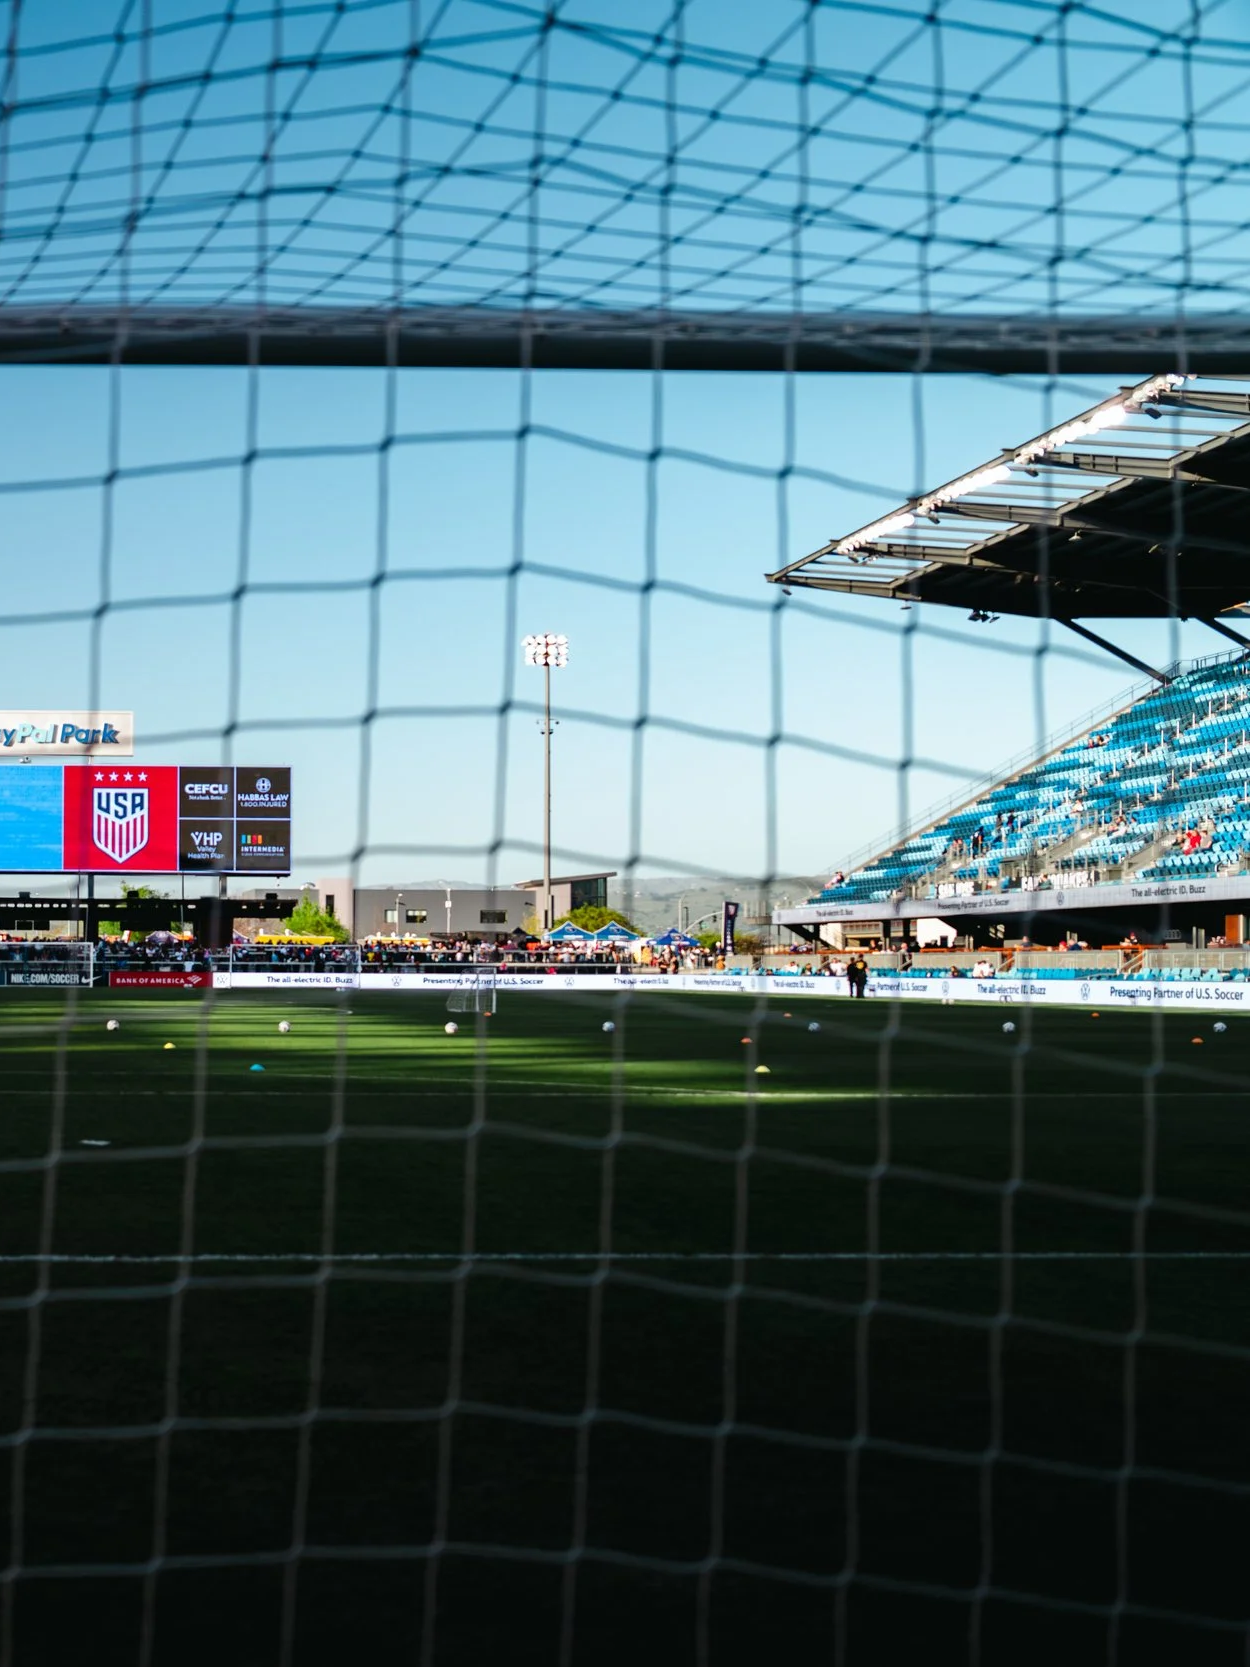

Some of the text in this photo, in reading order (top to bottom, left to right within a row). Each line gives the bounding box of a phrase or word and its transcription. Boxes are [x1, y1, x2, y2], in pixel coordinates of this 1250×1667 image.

[60, 723, 119, 745] Park
[184, 783, 229, 794] CEFCU
[237, 793, 289, 801] HABBAS LAW
[97, 792, 145, 819] USA
[190, 831, 222, 846] VHP
[1132, 888, 1142, 897] The
[1144, 887, 1177, 897] all-electric
[1190, 885, 1206, 894] Buzz
[423, 977, 463, 985] Presenting
[465, 977, 492, 985] Partner
[1110, 986, 1243, 1000] Presenting Partner of U.S. Soccer
